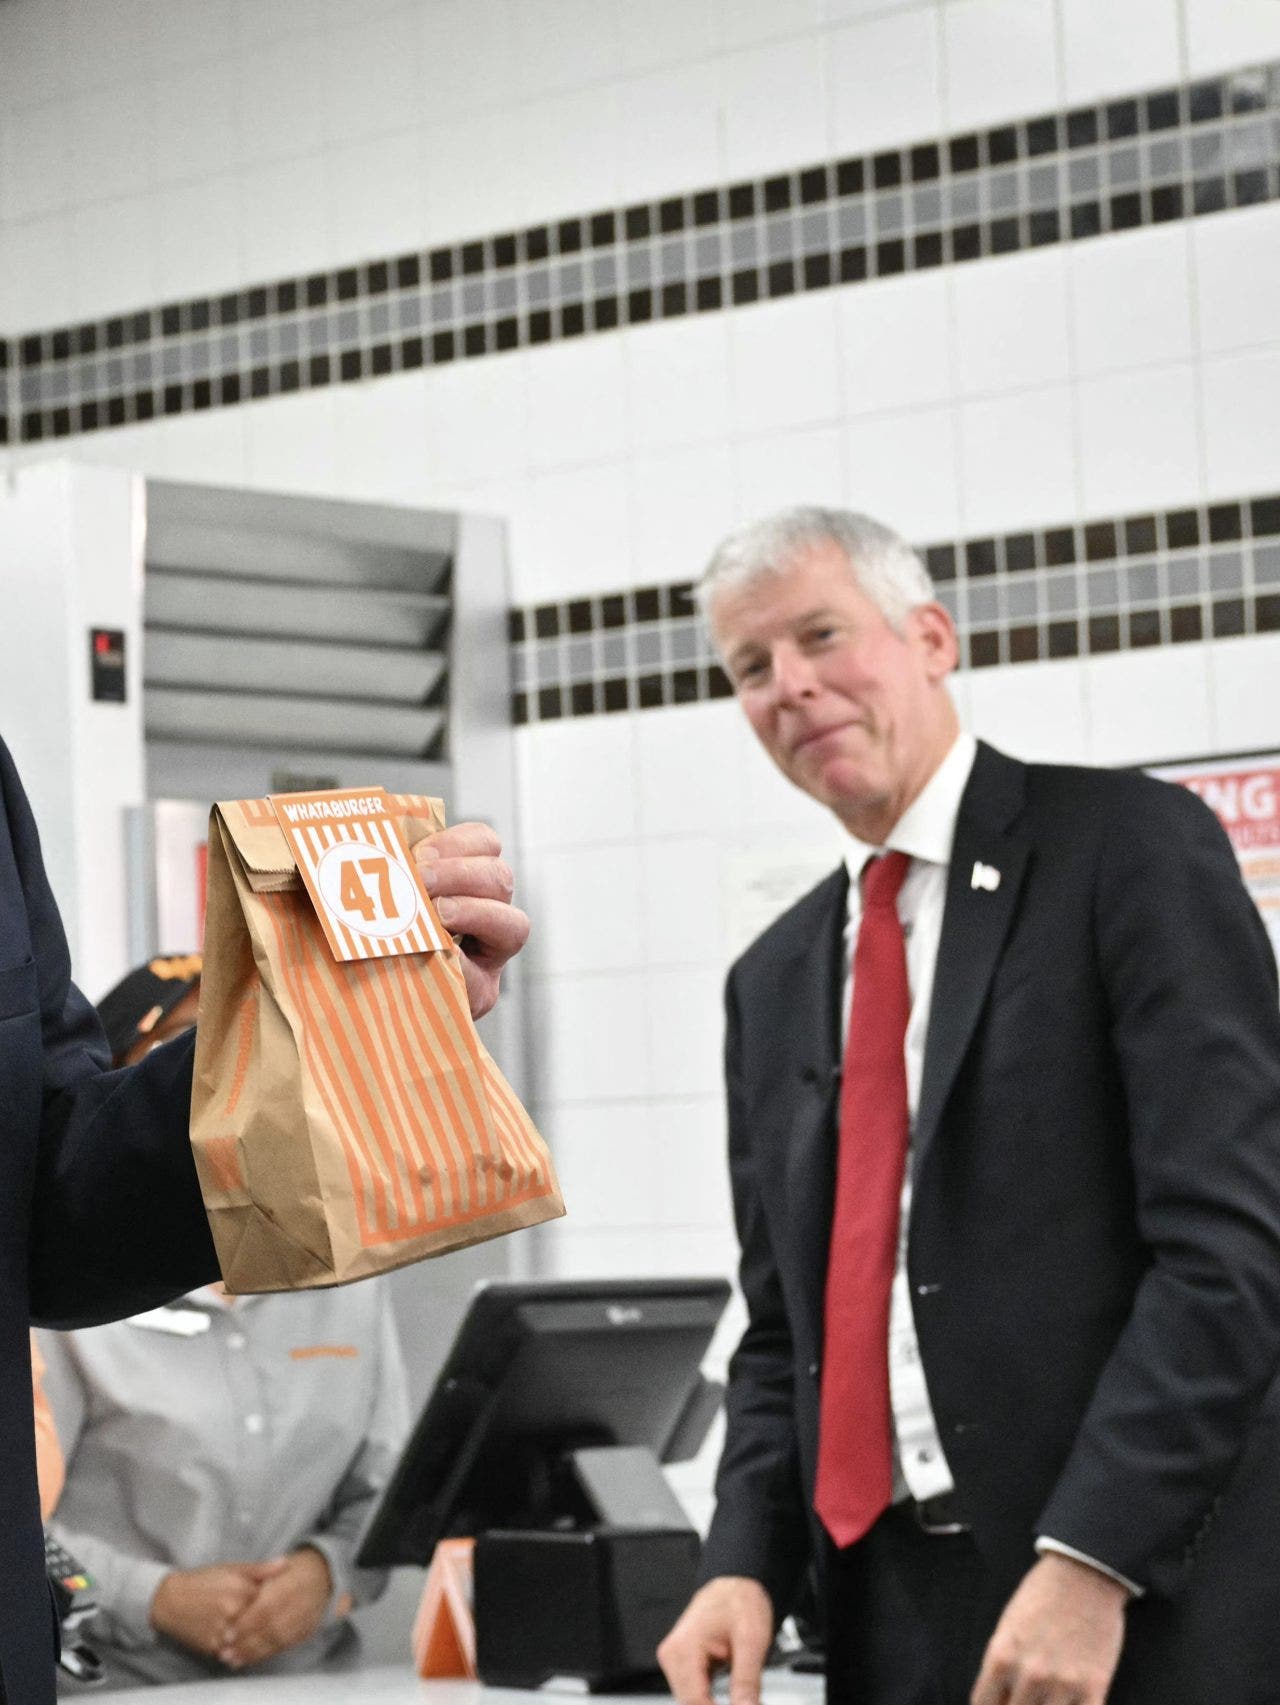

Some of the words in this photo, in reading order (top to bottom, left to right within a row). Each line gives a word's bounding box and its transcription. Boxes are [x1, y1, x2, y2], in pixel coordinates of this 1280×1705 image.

[282, 797, 387, 823] WHATABURGER
[1186, 774, 1276, 823] NG
[340, 857, 400, 922] 47
